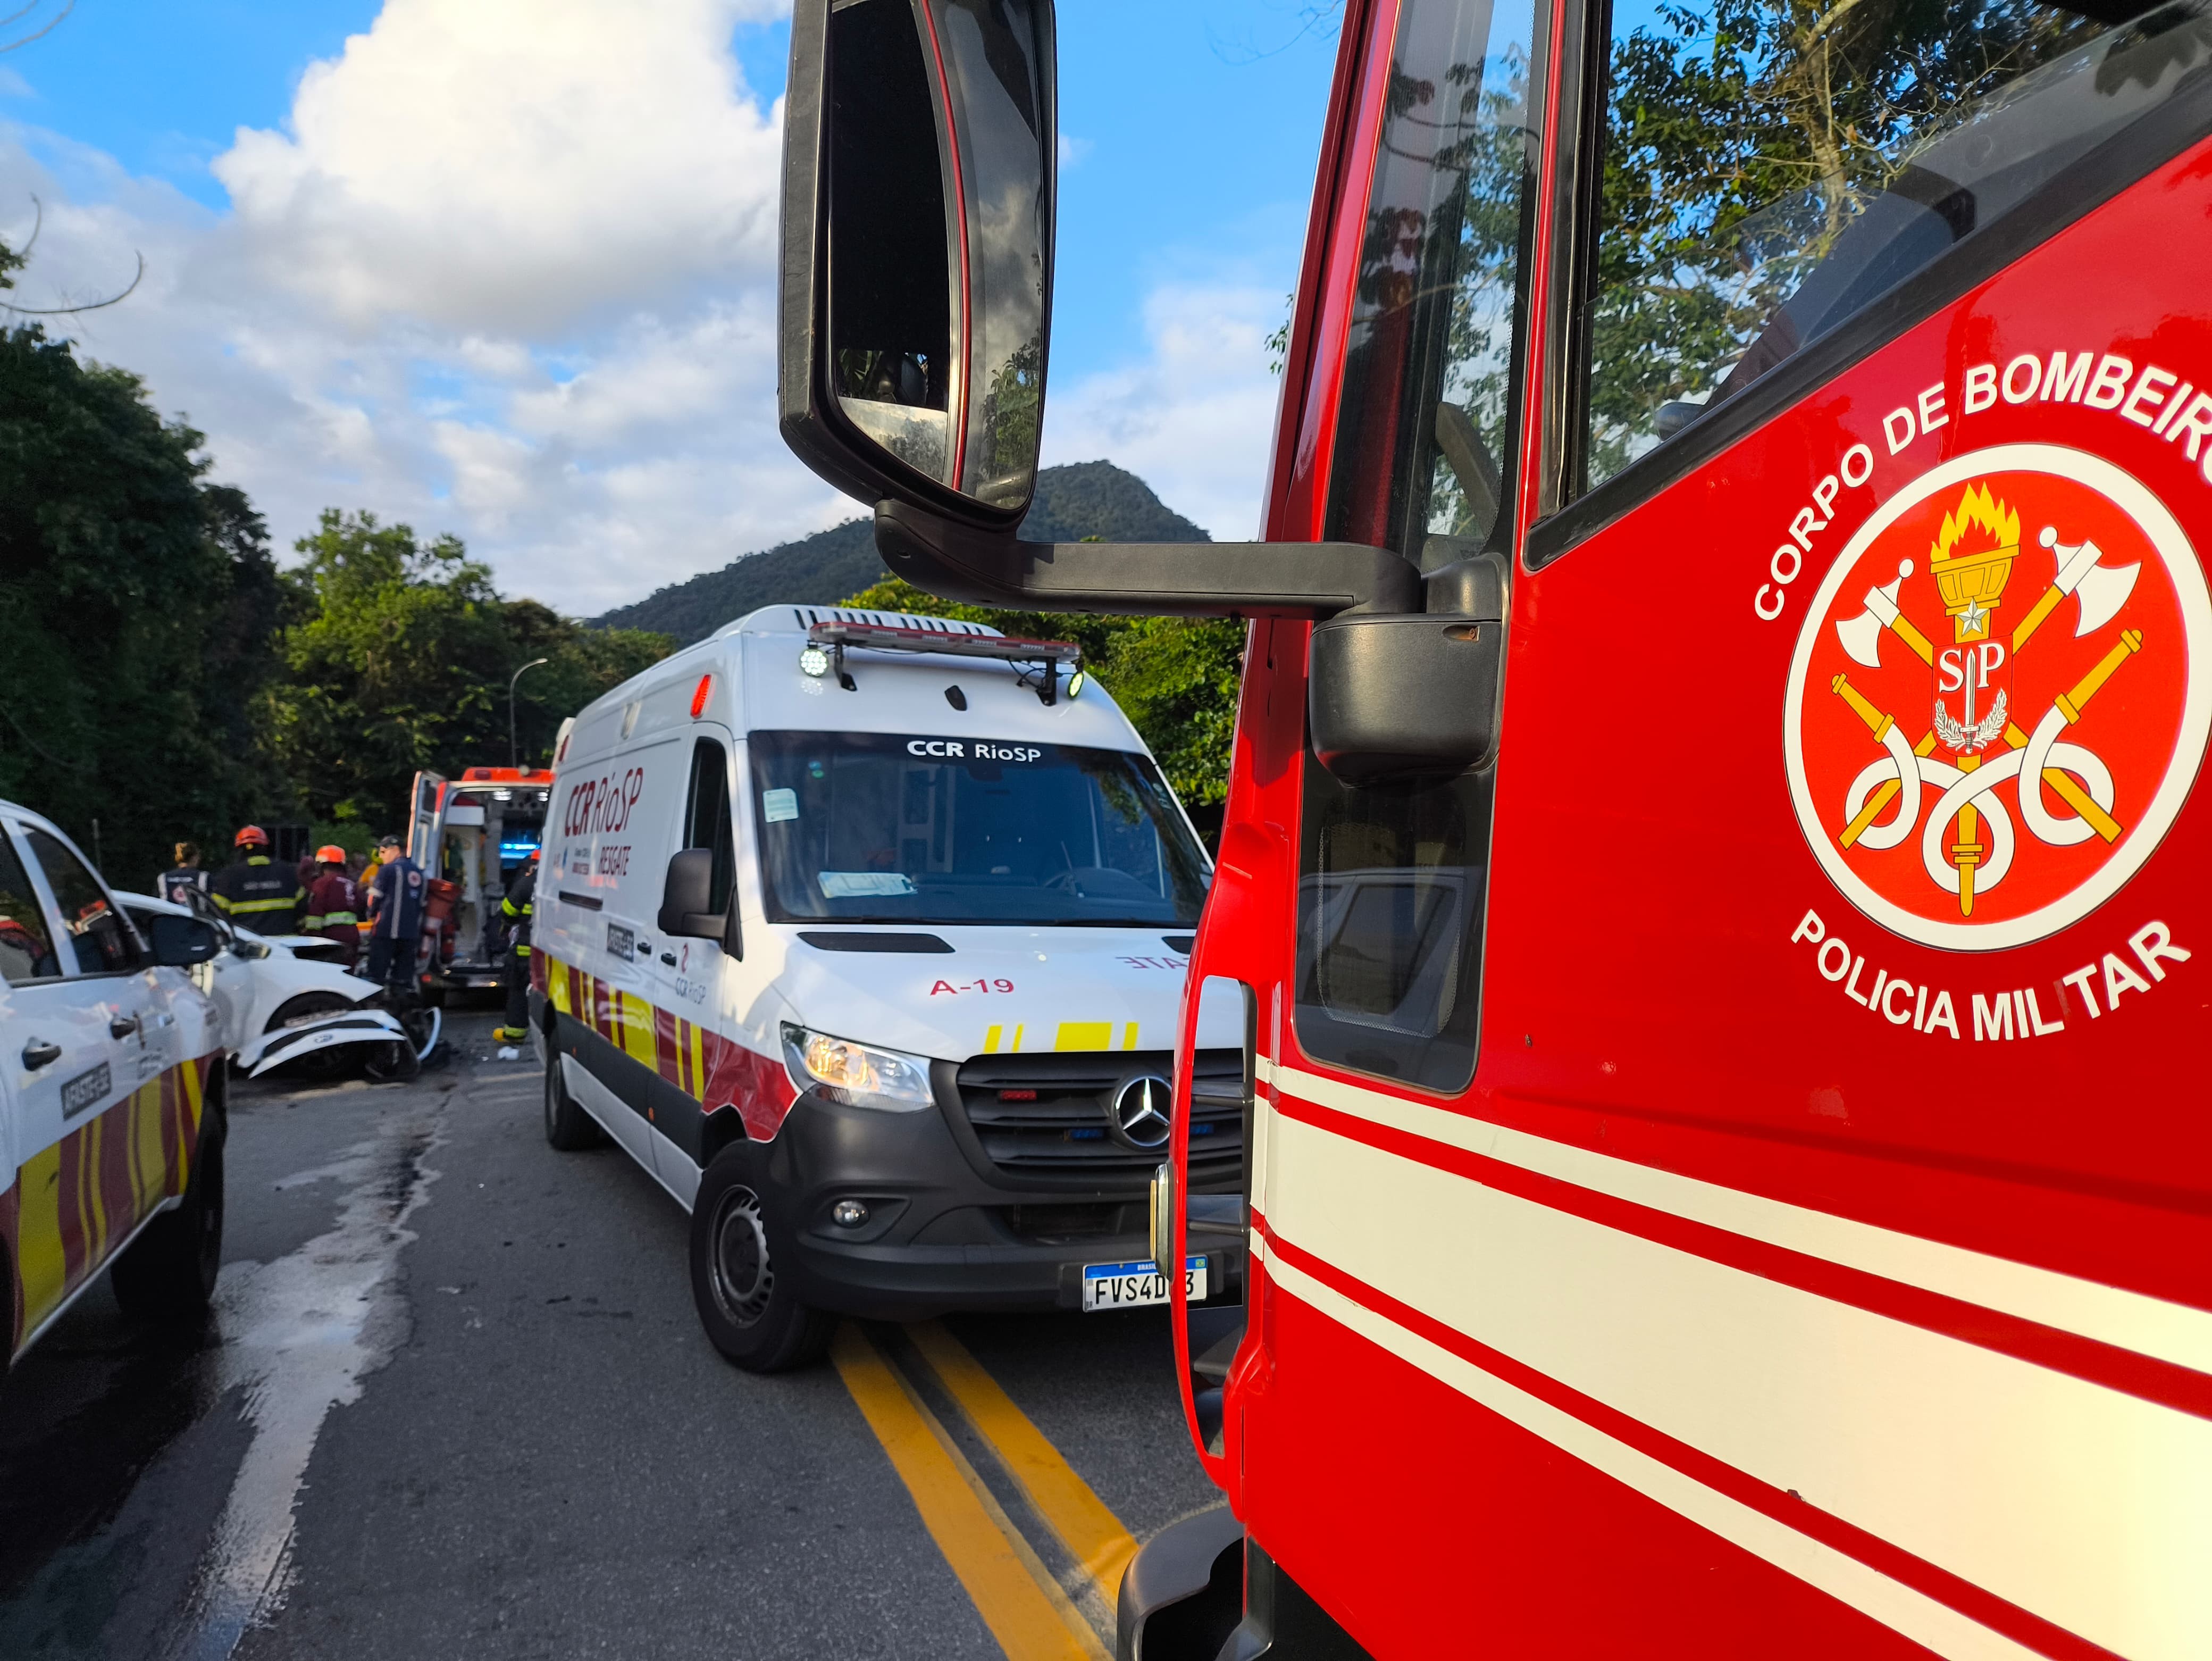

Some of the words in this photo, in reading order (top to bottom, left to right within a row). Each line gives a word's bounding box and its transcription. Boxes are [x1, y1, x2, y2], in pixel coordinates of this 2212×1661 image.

[1755, 444, 1874, 621] CORPO
[1882, 382, 1950, 456] DE
[907, 740, 965, 757] CCR
[975, 744, 1042, 763] RioSP
[564, 780, 596, 838] CCR
[590, 767, 643, 833] RioSP
[598, 846, 632, 877] RESGATE
[929, 978, 1015, 996] A-19
[1790, 908, 1960, 1040] POLICIA
[1095, 1272, 1194, 1305] FVS4D3
